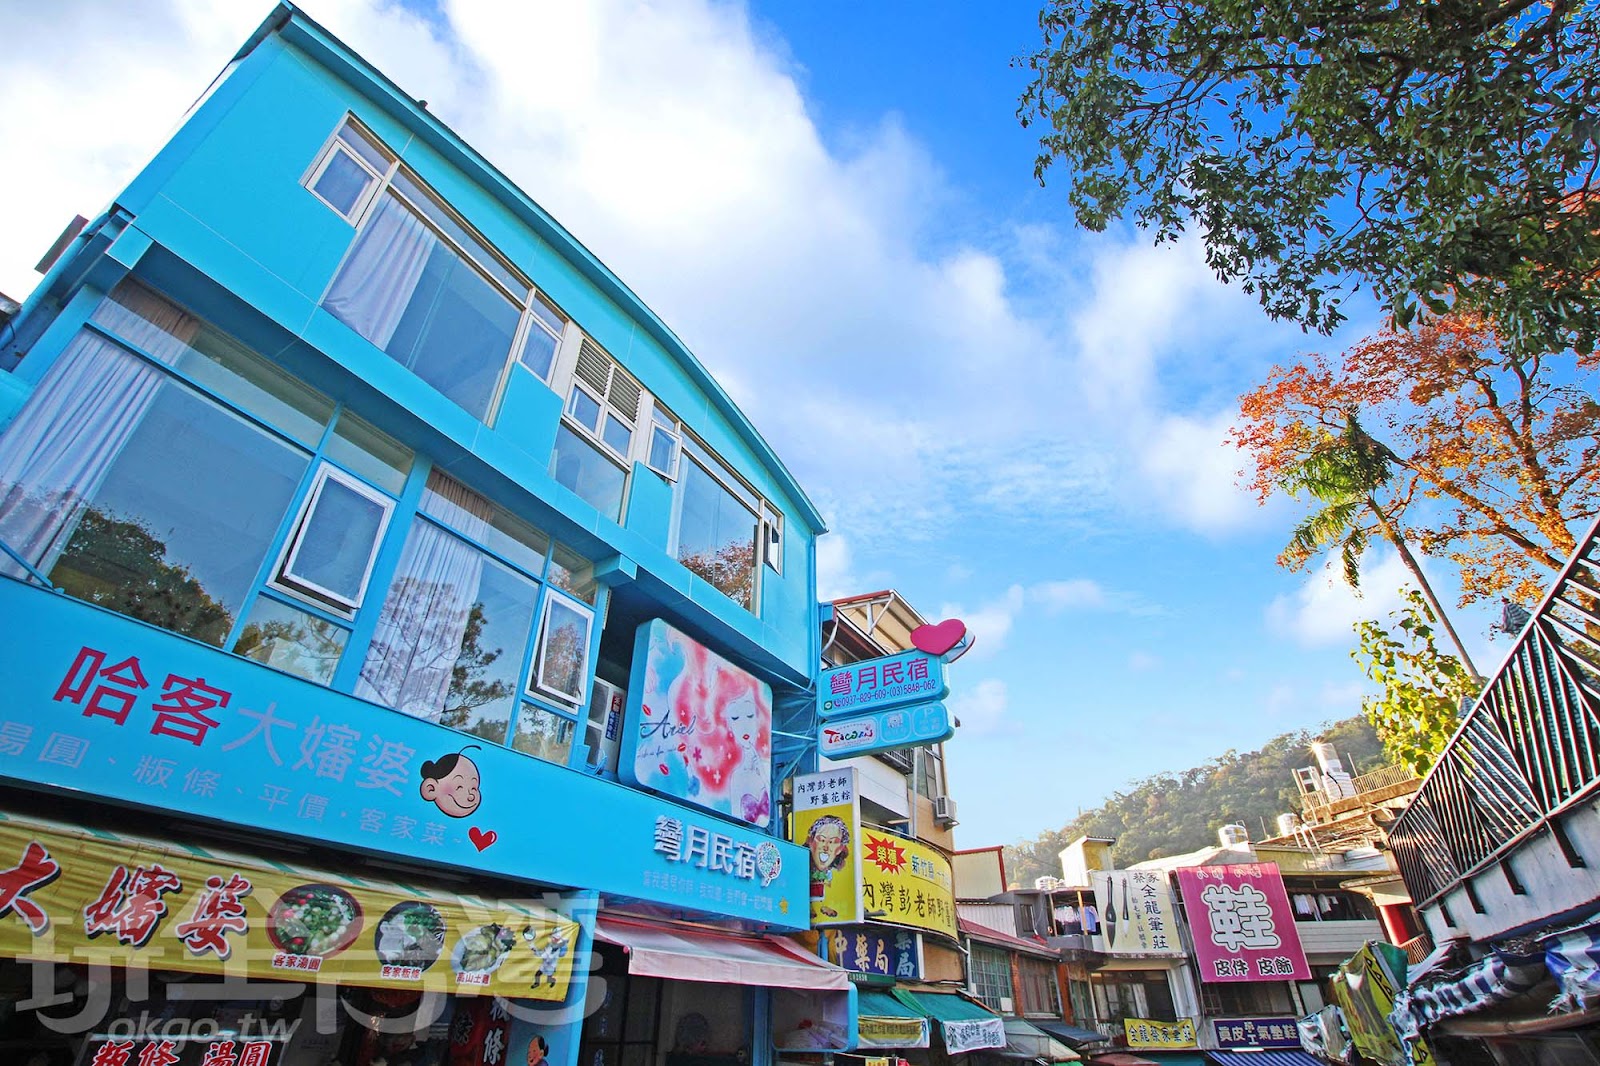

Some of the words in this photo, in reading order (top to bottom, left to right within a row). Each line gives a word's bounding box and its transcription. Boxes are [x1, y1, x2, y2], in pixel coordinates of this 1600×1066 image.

[830, 657, 929, 696] 彎月民宿
[52, 645, 416, 798] 哈客大嬸婆
[639, 709, 697, 739] Ariel
[0, 839, 253, 962] 大嬸婆
[1201, 883, 1281, 953] 鞋
[1214, 958, 1249, 977] 皮件
